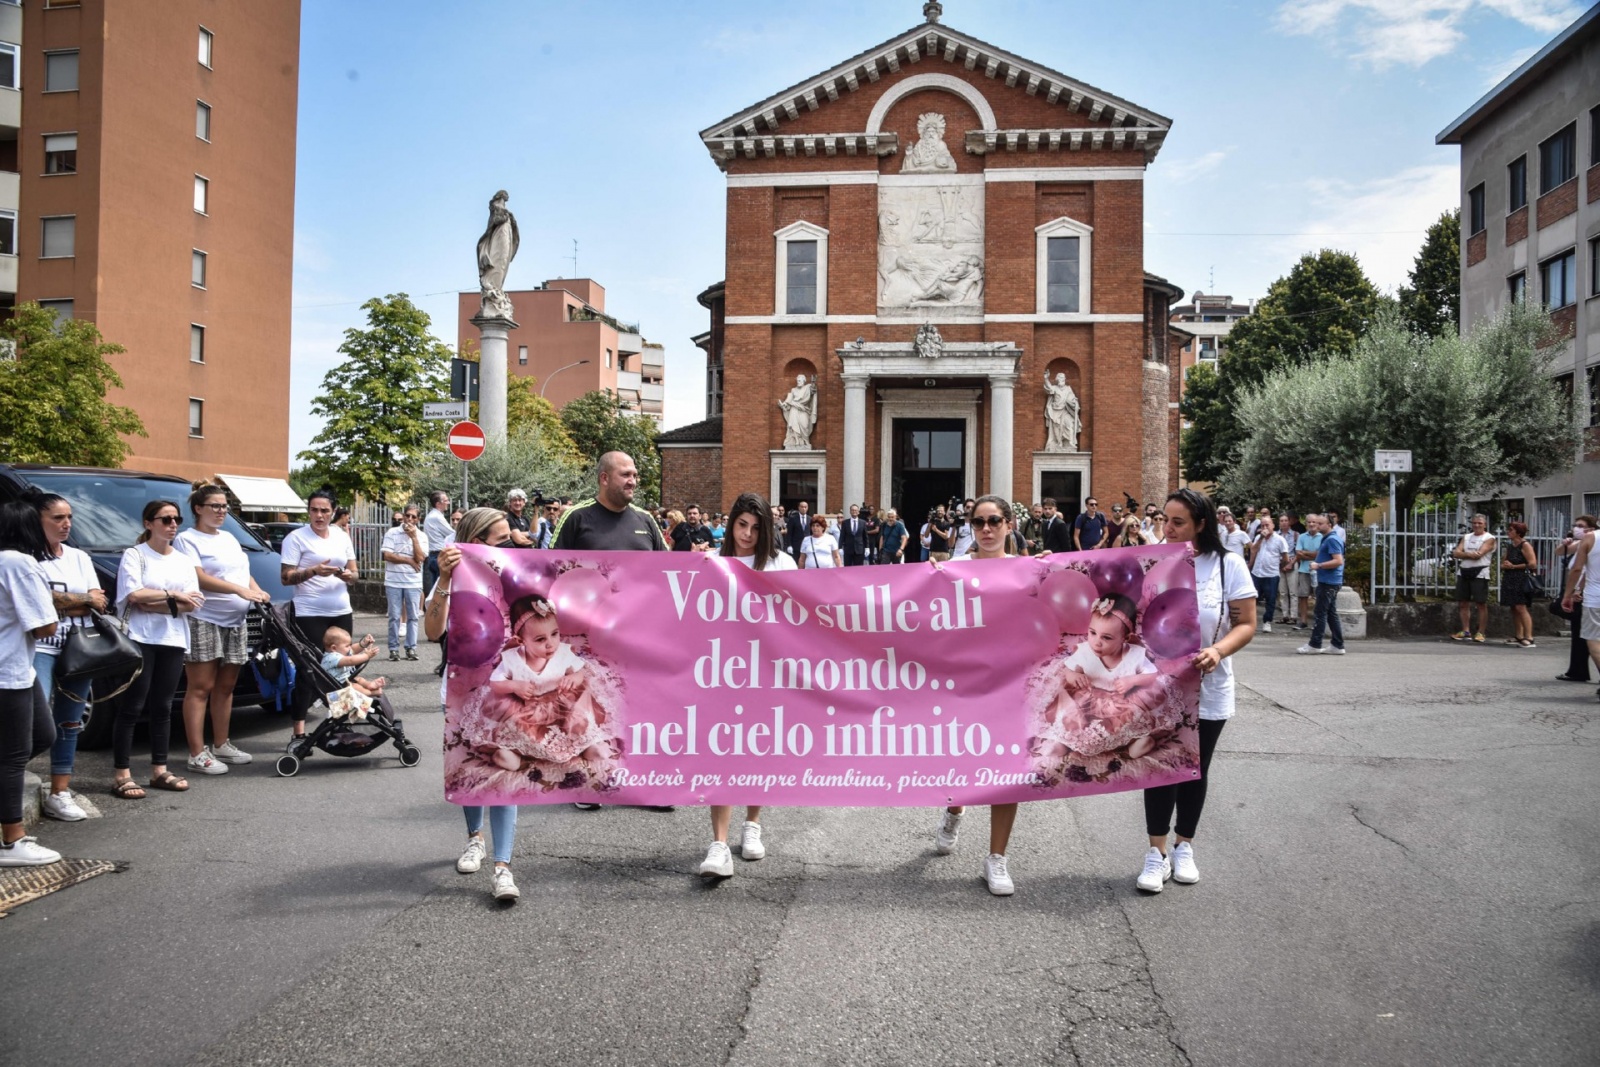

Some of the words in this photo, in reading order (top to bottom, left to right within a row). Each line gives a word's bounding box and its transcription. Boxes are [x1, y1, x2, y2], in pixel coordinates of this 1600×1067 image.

[662, 570, 809, 627] Volerò
[815, 583, 921, 634] sulle
[930, 577, 987, 631] ali
[694, 637, 762, 690] del
[771, 647, 956, 692] mondo..
[629, 704, 700, 756] nel
[708, 704, 814, 757] cielo
[823, 705, 1021, 757] infinito..
[609, 767, 685, 788] Resterò
[690, 773, 723, 792] per
[727, 773, 798, 792] sempre
[802, 767, 892, 791] bambina,
[897, 767, 968, 793] piccola
